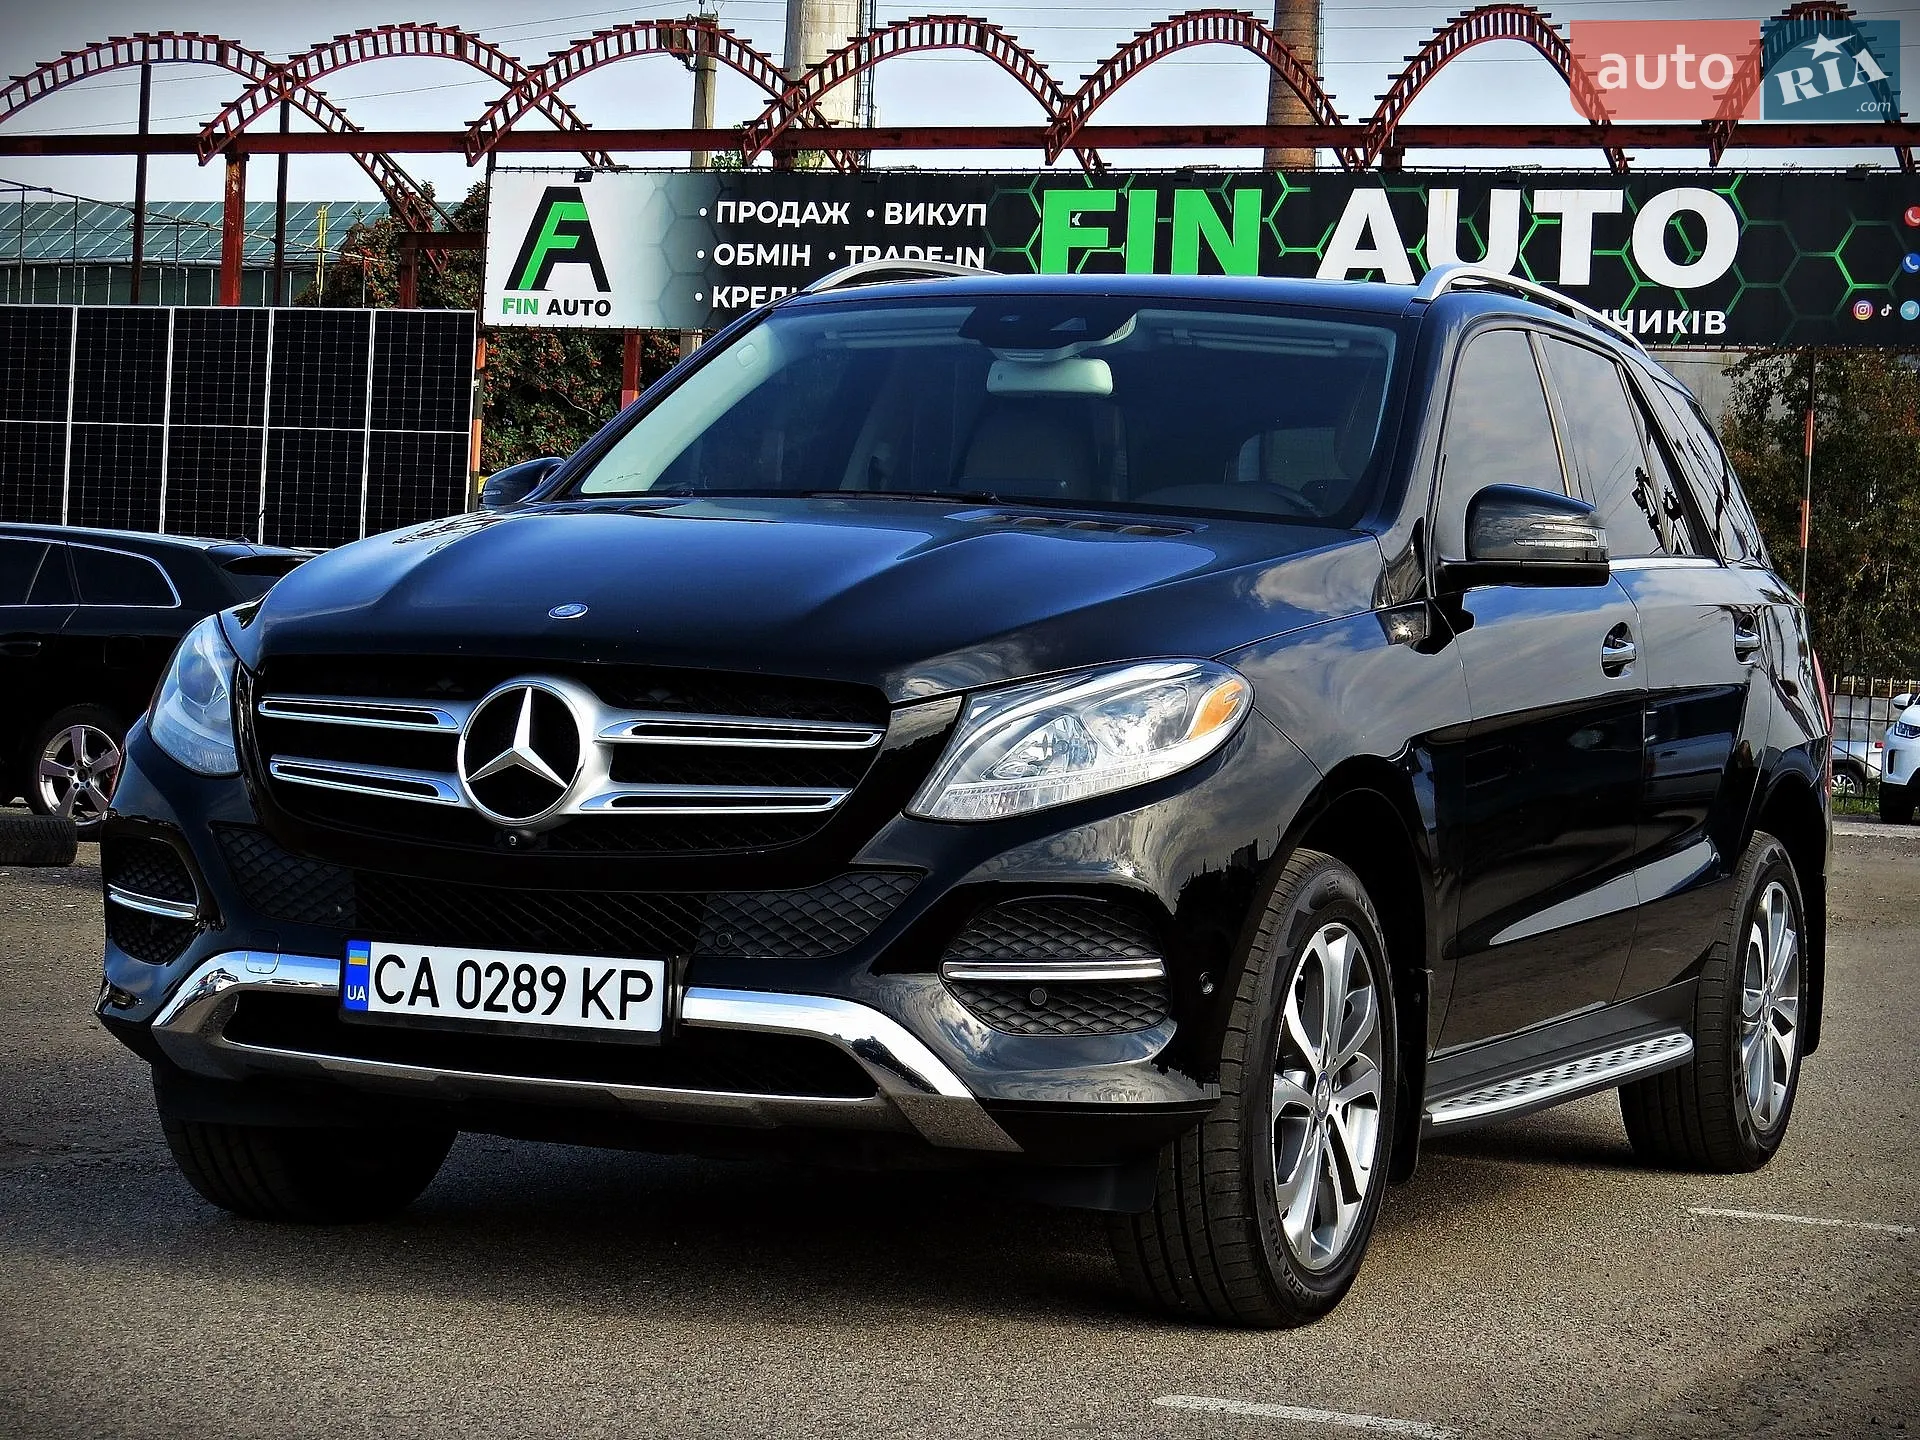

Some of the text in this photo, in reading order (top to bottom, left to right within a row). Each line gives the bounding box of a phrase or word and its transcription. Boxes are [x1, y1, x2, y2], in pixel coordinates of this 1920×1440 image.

[716, 200, 988, 228] ПРОДАЖ ВИКУП
[1040, 188, 1740, 289] FIN AUTO
[713, 243, 986, 270] ОБМІН TRADE-IN
[502, 298, 612, 316] FIN AUTO
[712, 286, 798, 308] КРЕД
[347, 984, 367, 1001] UA
[374, 953, 654, 1021] CA 0289 KP
